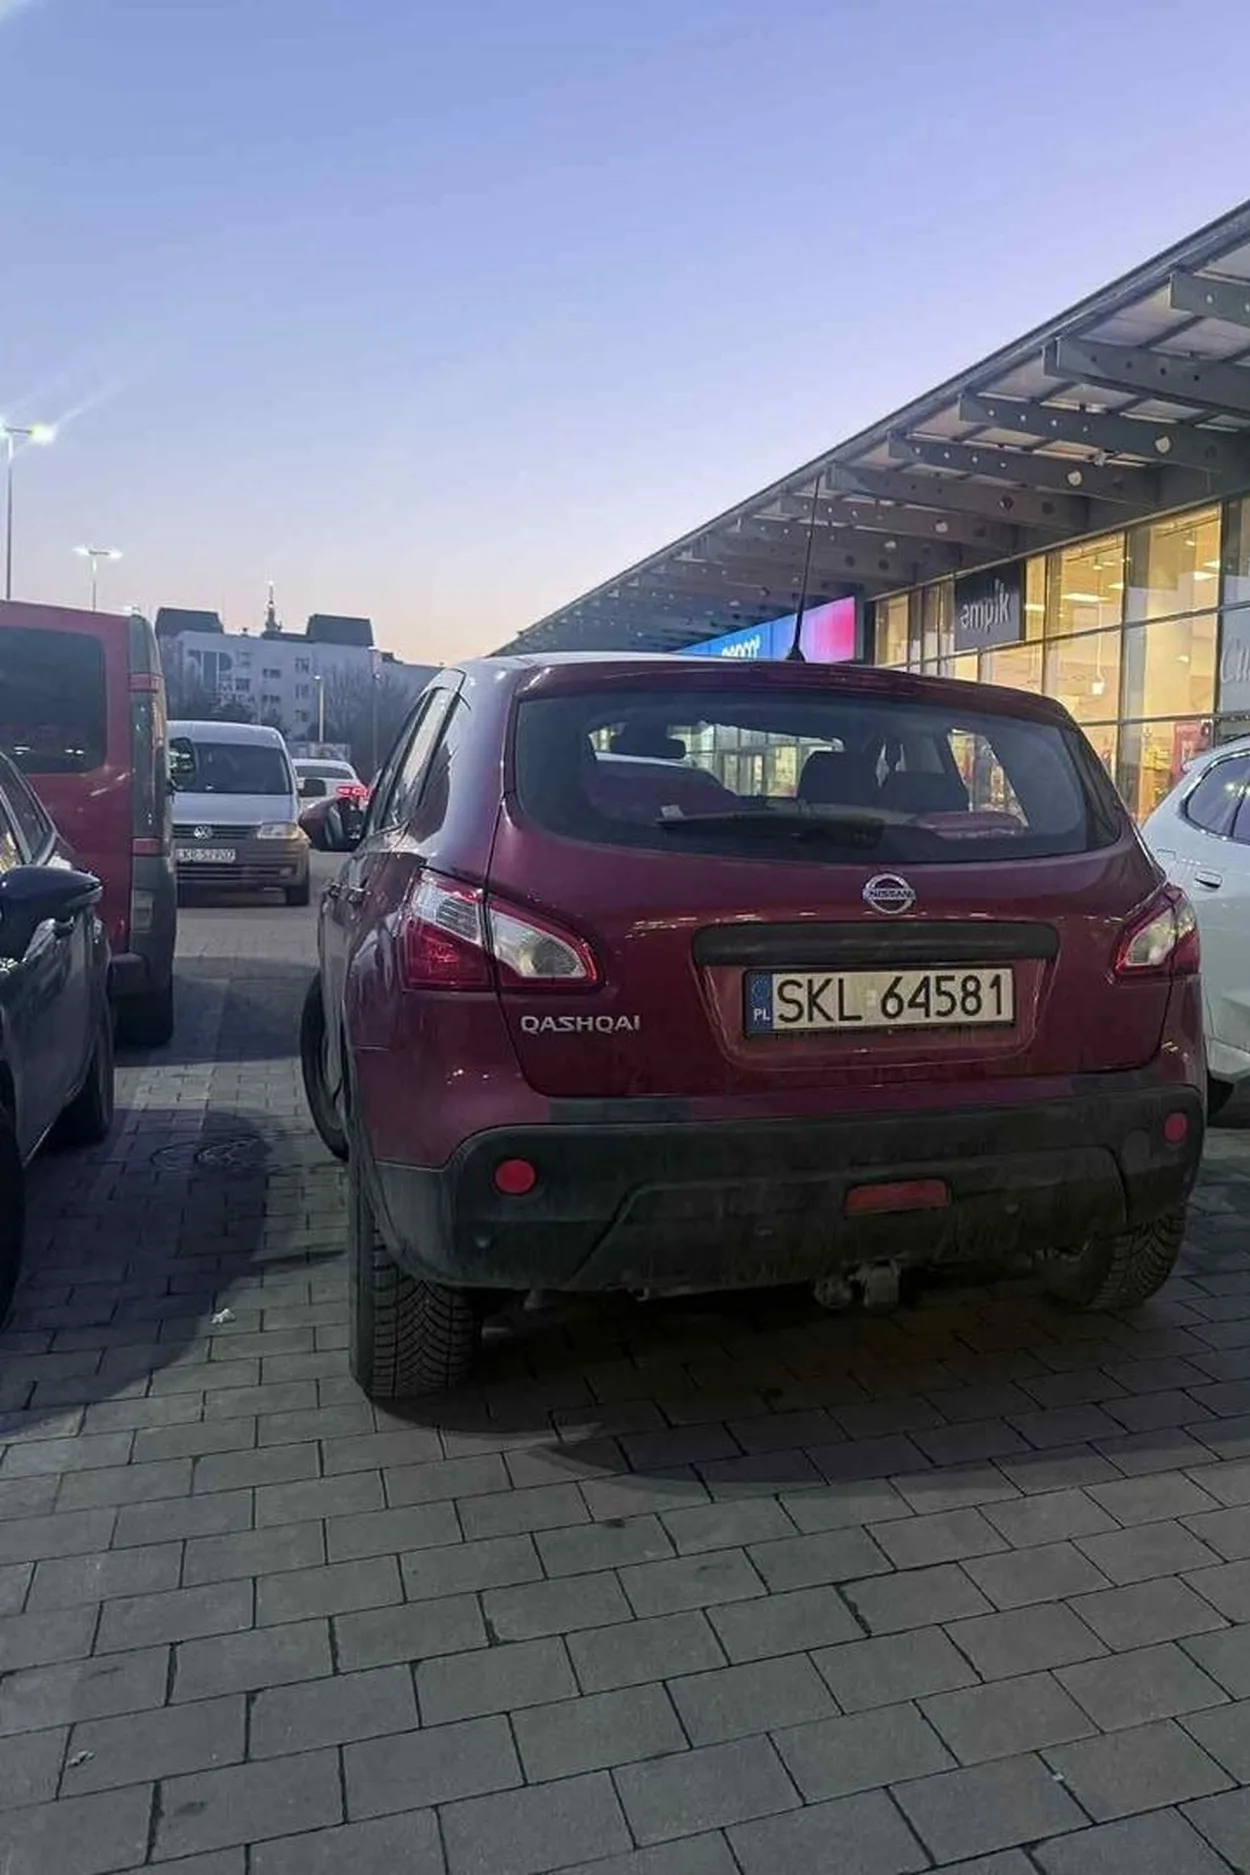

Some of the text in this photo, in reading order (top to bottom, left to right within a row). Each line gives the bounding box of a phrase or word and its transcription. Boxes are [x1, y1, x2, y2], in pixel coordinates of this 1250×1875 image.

[959, 578, 1010, 633] empik
[753, 973, 1004, 1023] PL SKL 64581
[520, 1014, 640, 1035] QASHQAI
